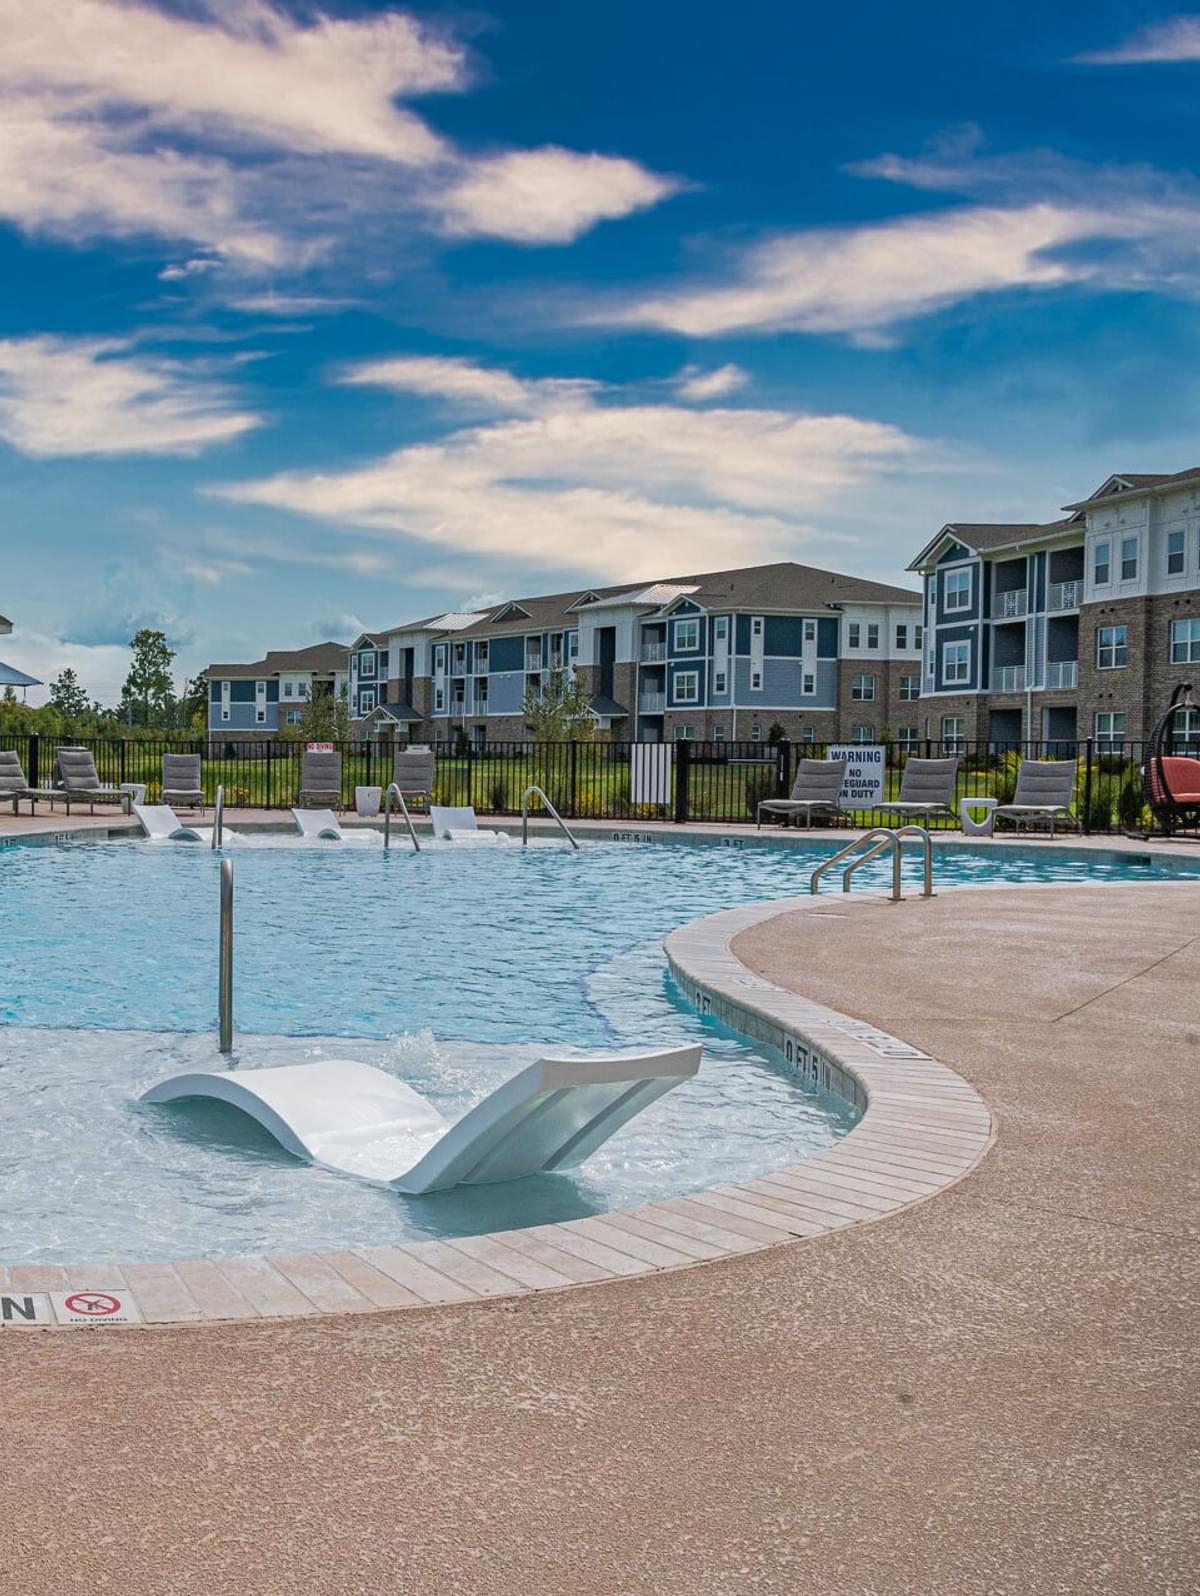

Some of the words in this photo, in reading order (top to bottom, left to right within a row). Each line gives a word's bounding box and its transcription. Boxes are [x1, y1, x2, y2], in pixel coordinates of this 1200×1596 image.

[831, 751, 881, 763] WARNING
[849, 769, 862, 777] NO
[842, 780, 880, 788] EGUARD
[851, 790, 875, 798] DUTY
[786, 1040, 793, 1062] 0
[796, 1045, 808, 1072] FT
[811, 1055, 818, 1081] 5
